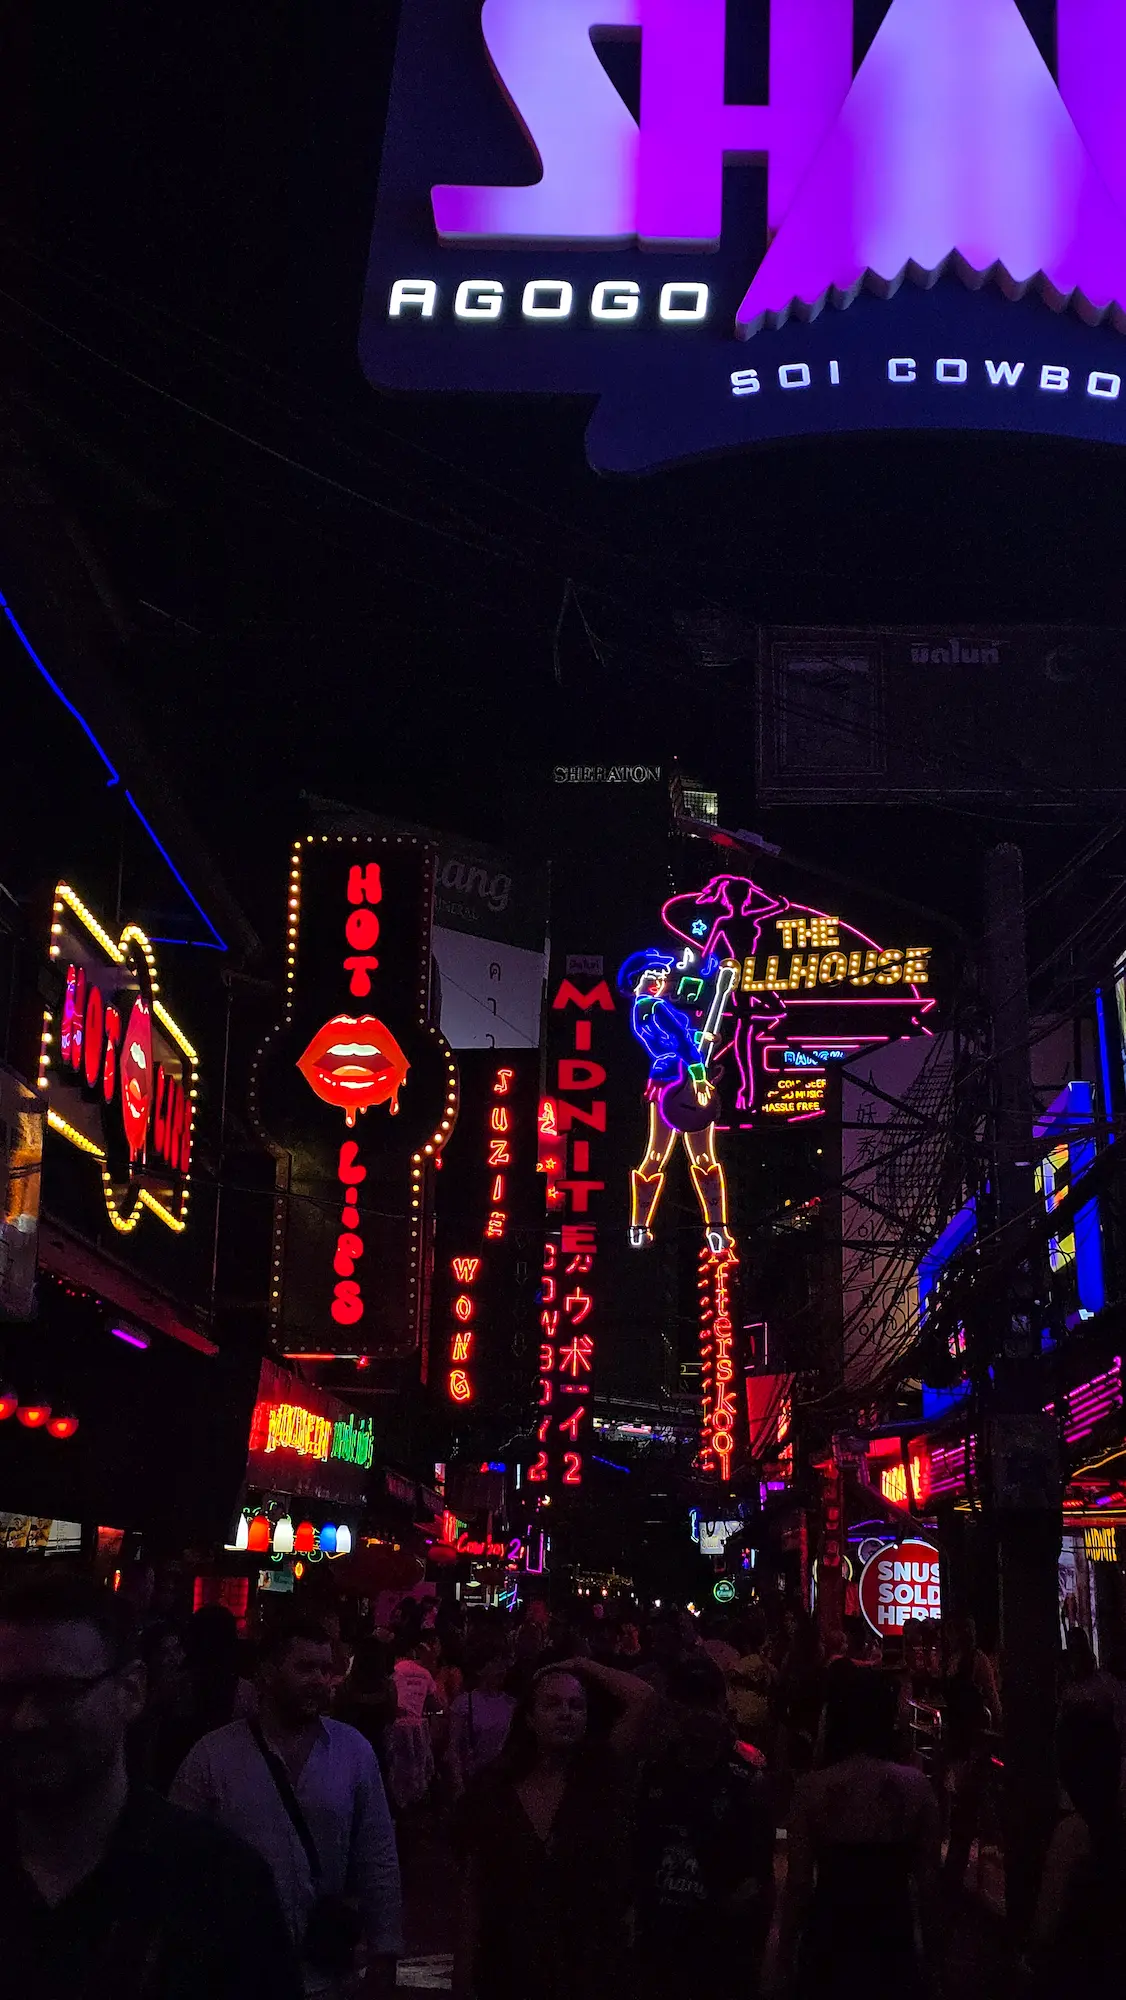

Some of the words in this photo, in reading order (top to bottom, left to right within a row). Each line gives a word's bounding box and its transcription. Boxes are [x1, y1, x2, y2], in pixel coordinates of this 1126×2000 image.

[389, 279, 711, 320] AGOGO
[731, 360, 841, 395] SOI
[554, 765, 661, 783] SHERATON
[343, 862, 382, 997] HOT
[776, 916, 840, 949] THE
[61, 963, 121, 1104] HOT
[552, 979, 616, 1252] MIDNITE
[762, 1102, 795, 1113] HASSLE
[796, 1101, 821, 1112] FREE
[486, 1068, 513, 1237] SUZIE
[330, 1141, 367, 1325] LIPS
[449, 1257, 480, 1404] WONG
[877, 1561, 940, 1584] SNUS
[878, 1583, 941, 1605] SOLD
